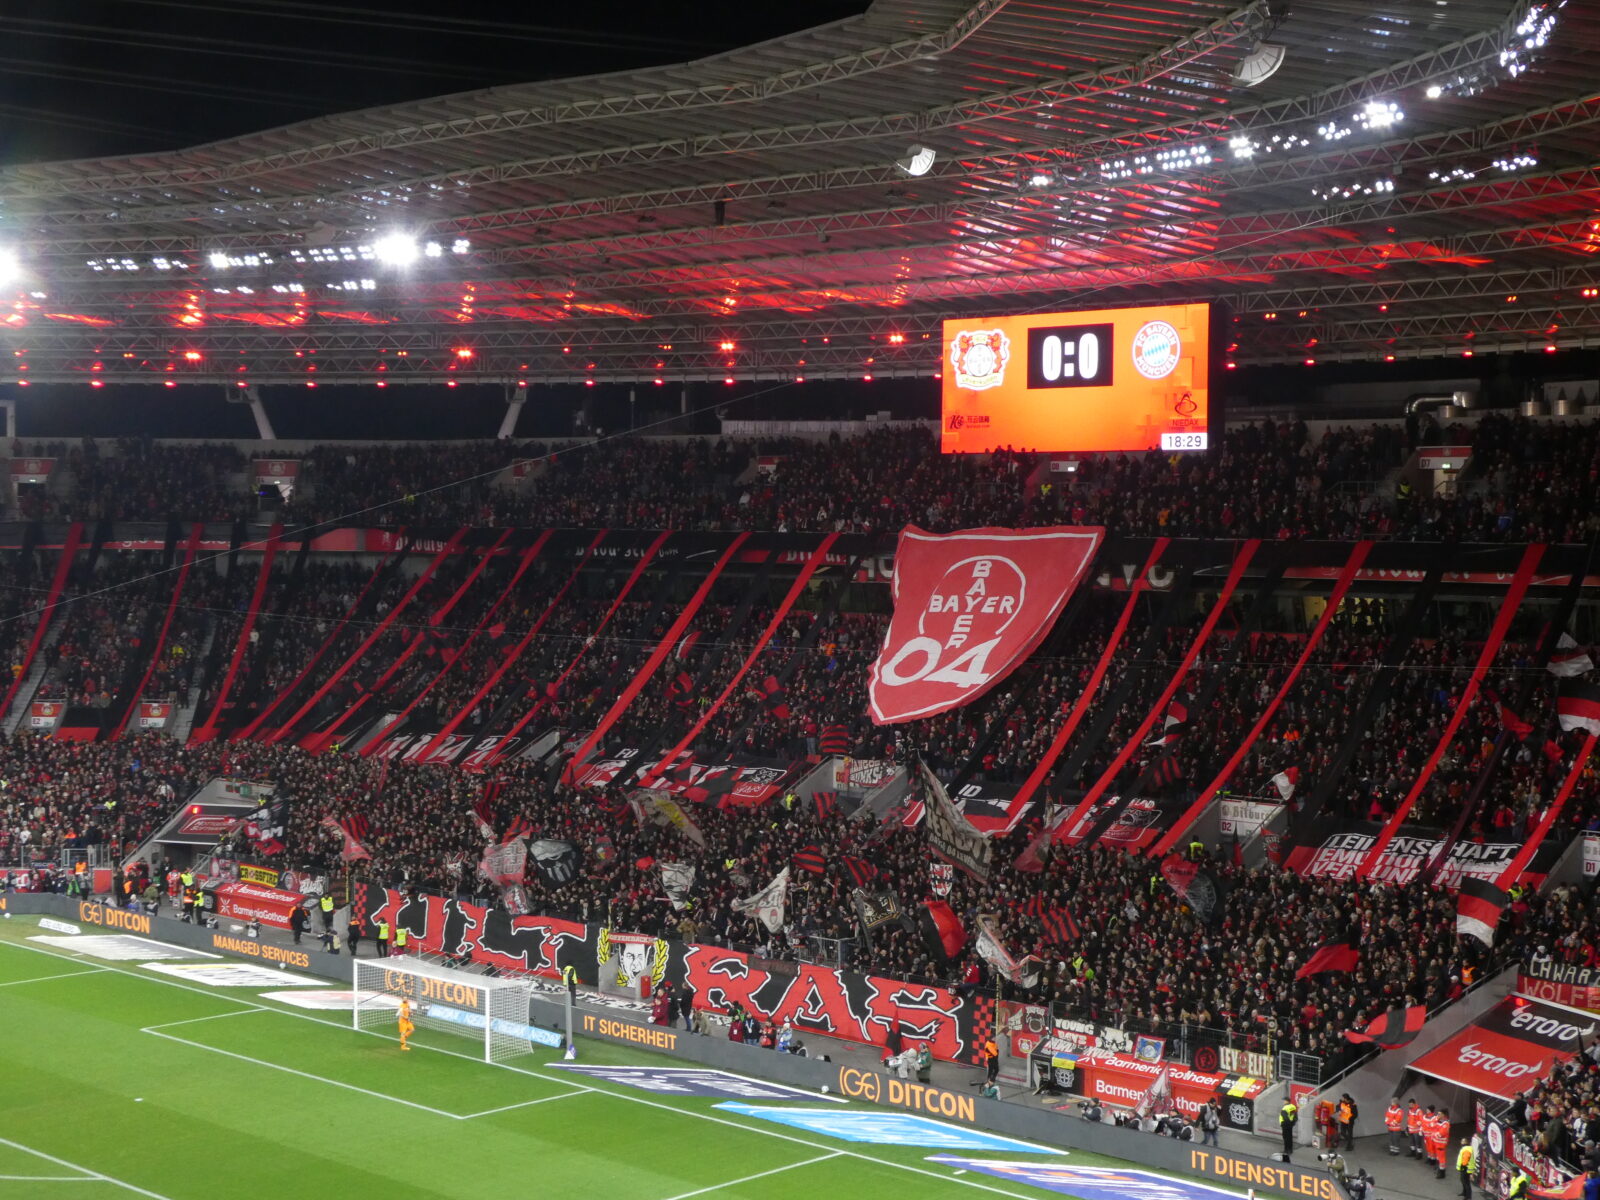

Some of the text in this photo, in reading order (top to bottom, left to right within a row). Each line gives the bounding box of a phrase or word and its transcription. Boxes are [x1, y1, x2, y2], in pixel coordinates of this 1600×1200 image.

[1042, 332, 1099, 381] 0:0
[1167, 435, 1202, 448] 18:29
[928, 594, 1015, 615] BAYER
[880, 635, 1002, 688] 04
[1221, 821, 1232, 832] D2
[1585, 862, 1596, 873] D1
[105, 907, 151, 934] DITCON
[232, 903, 289, 924] BarmeniaGothaer
[213, 934, 309, 967] MANAGED SERVICES
[583, 1014, 677, 1050] IT SICHERHEIT
[1055, 1018, 1095, 1035] YOUNG
[1219, 1046, 1239, 1072] LEV
[888, 1079, 975, 1122] DITCON
[1191, 1150, 1209, 1171] IT
